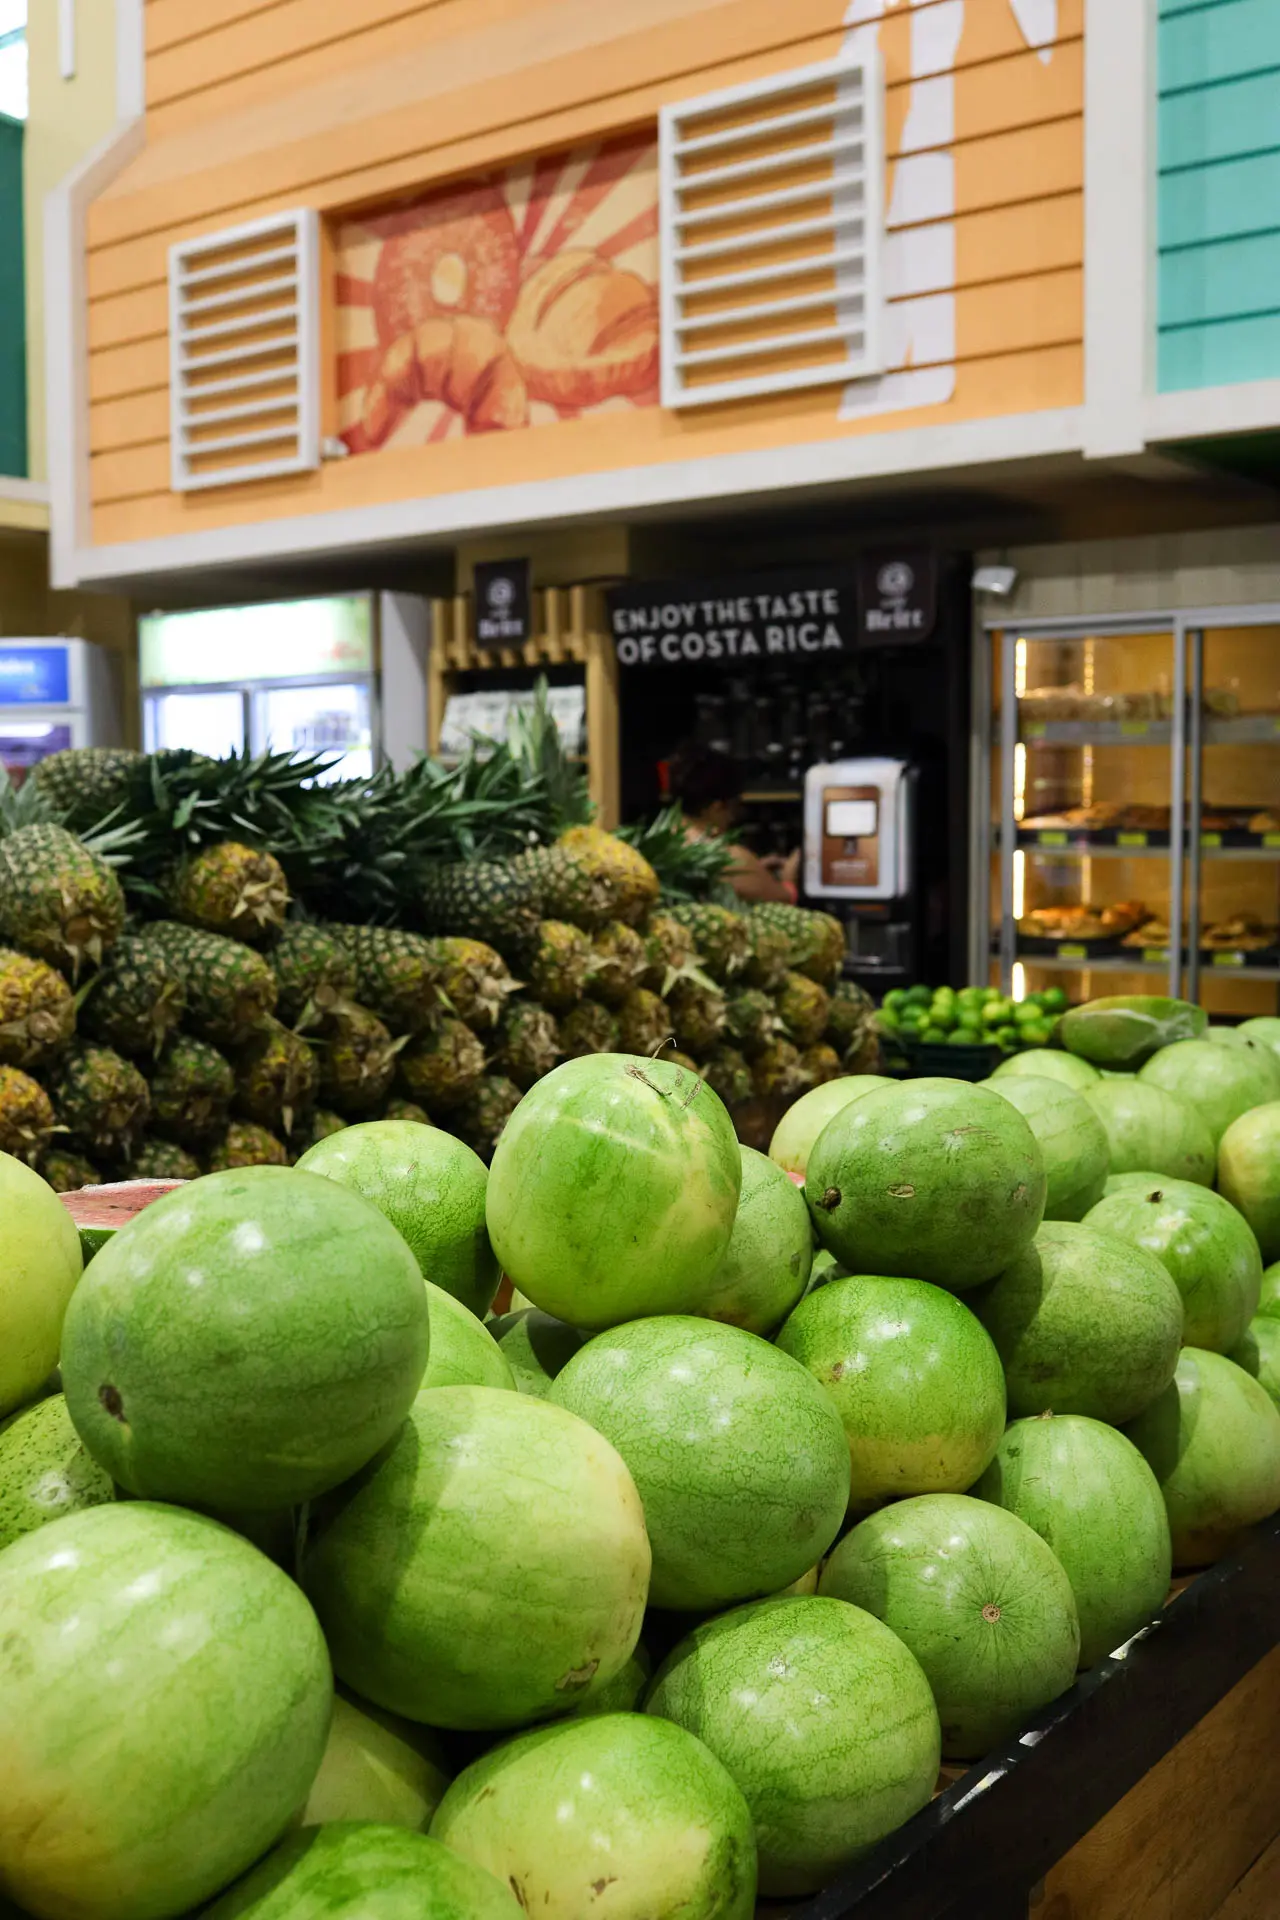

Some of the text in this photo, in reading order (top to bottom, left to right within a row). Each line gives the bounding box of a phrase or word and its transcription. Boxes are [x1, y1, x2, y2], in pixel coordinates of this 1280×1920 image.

[613, 588, 839, 634] ENJOY THE TASTE
[617, 622, 842, 665] OF COSTA RICA
